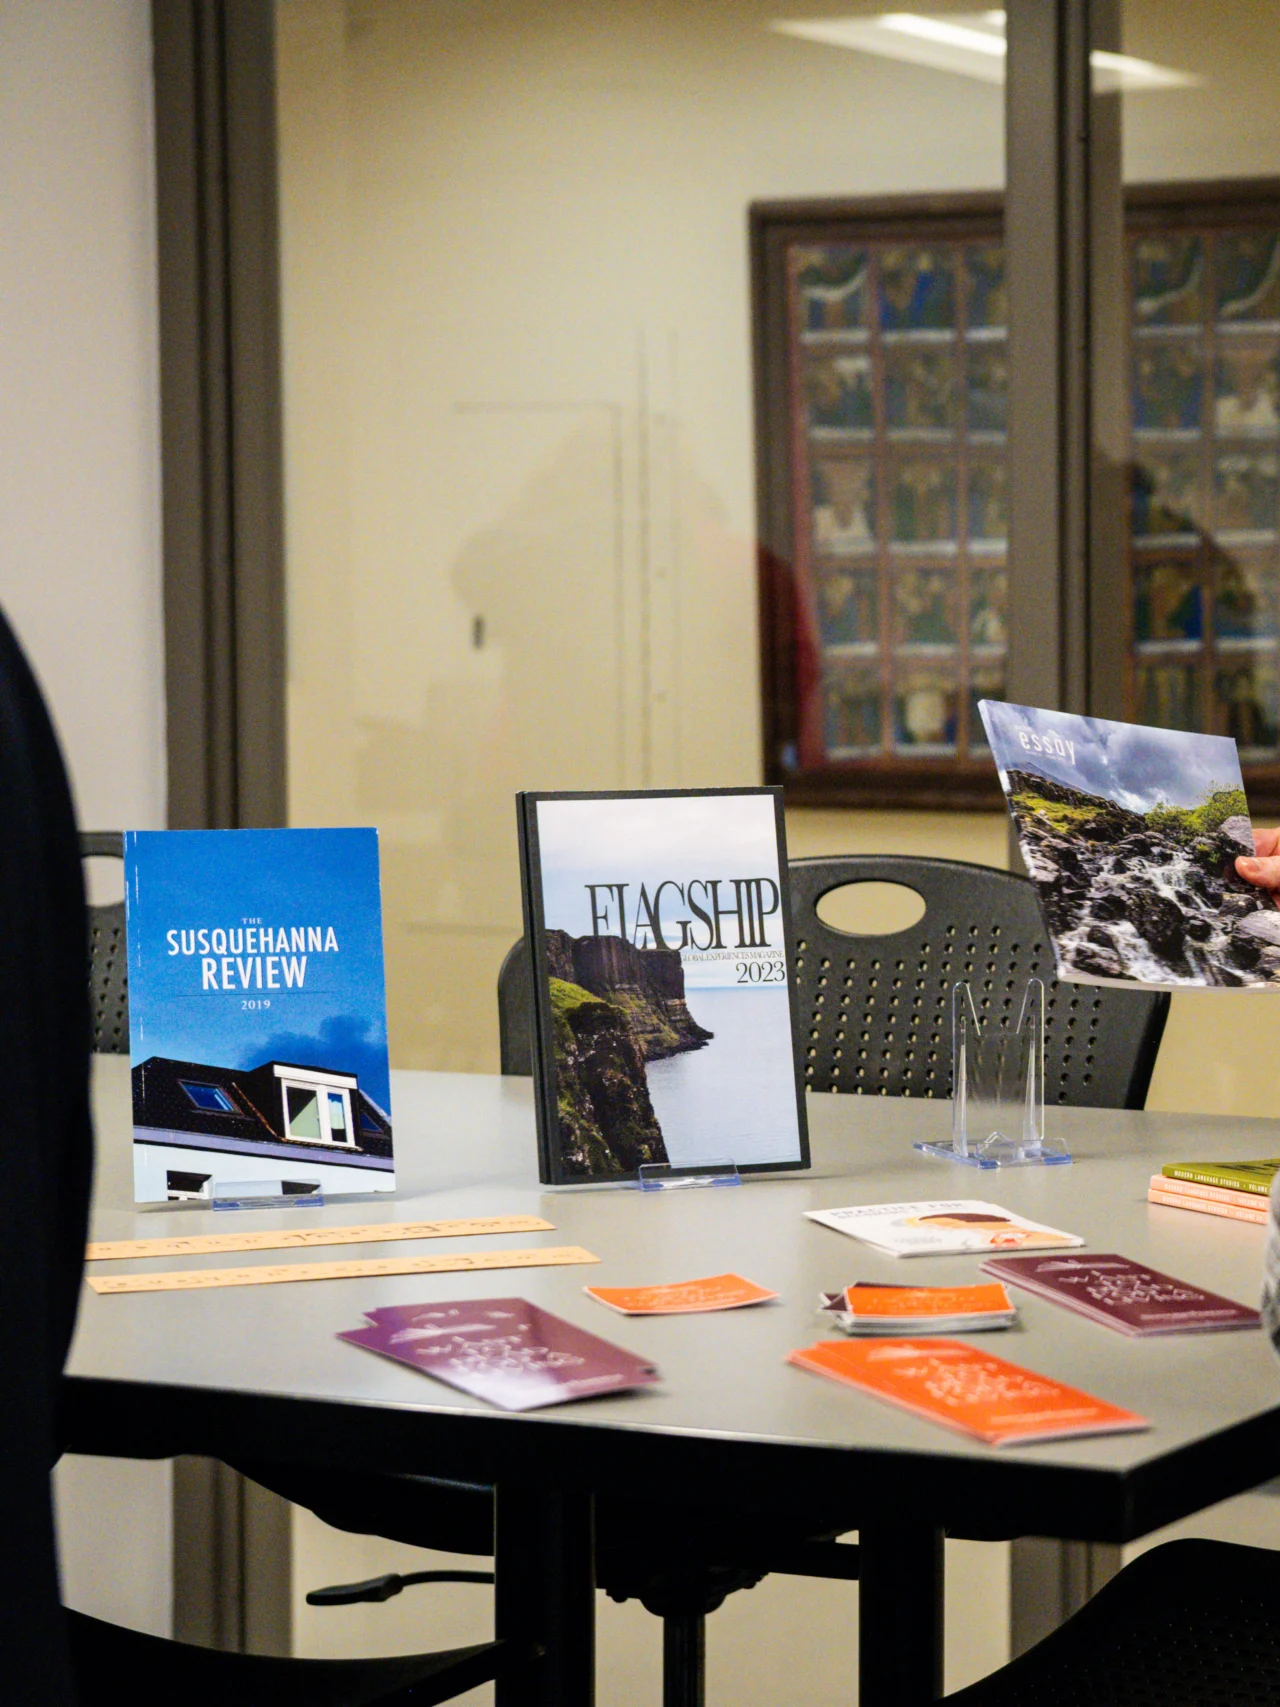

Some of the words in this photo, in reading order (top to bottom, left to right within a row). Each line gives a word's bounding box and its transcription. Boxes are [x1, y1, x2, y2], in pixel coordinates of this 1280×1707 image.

[1019, 731, 1076, 765] essay
[241, 917, 262, 925] THE
[166, 926, 339, 956] SUSQUEHANNA
[202, 956, 307, 991] REVIEW
[735, 960, 785, 983] 2023
[241, 999, 271, 1011] 2019
